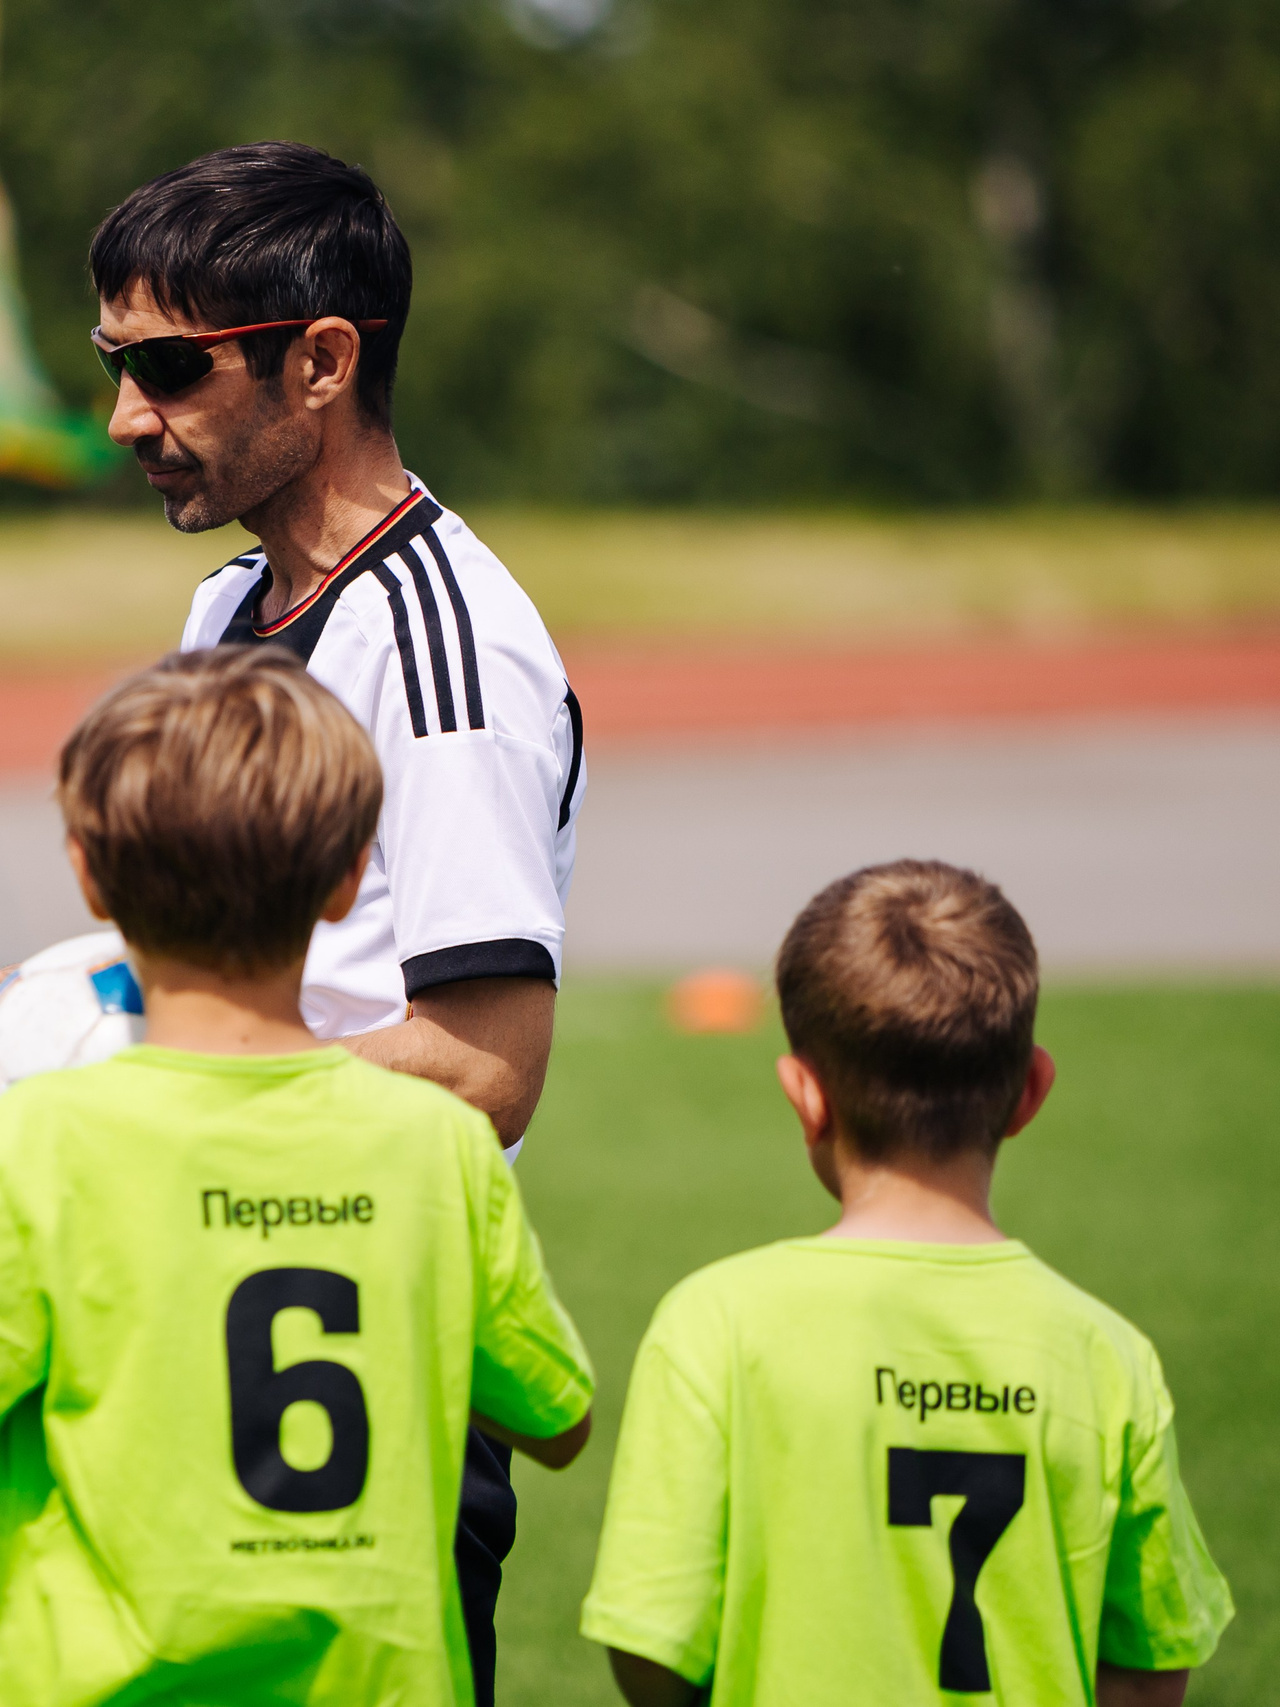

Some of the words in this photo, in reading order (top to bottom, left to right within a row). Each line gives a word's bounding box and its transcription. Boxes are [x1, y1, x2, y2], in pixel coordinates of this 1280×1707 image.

[201, 1189, 374, 1239] Первые
[225, 1267, 372, 1514] 6
[886, 1446, 1027, 1694] 7
